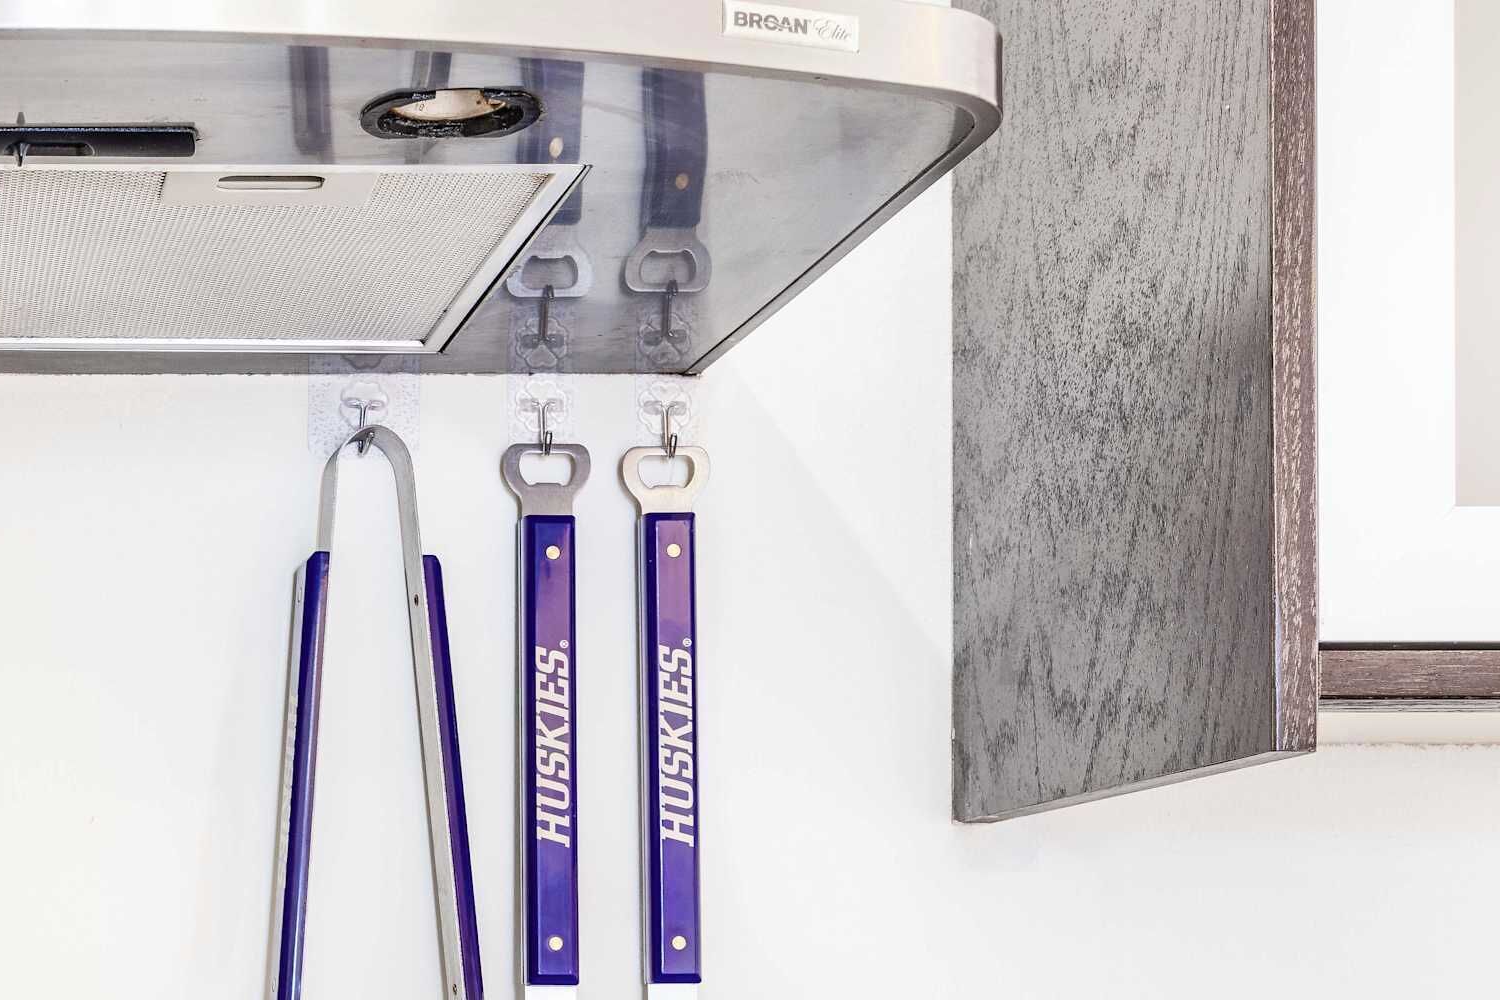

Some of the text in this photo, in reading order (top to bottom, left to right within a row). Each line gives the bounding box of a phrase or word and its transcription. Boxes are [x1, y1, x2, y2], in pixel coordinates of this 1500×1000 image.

[733, 11, 852, 41] BROAN Elite
[536, 645, 570, 849] HUSKIES
[658, 644, 695, 849] HUSKIES
